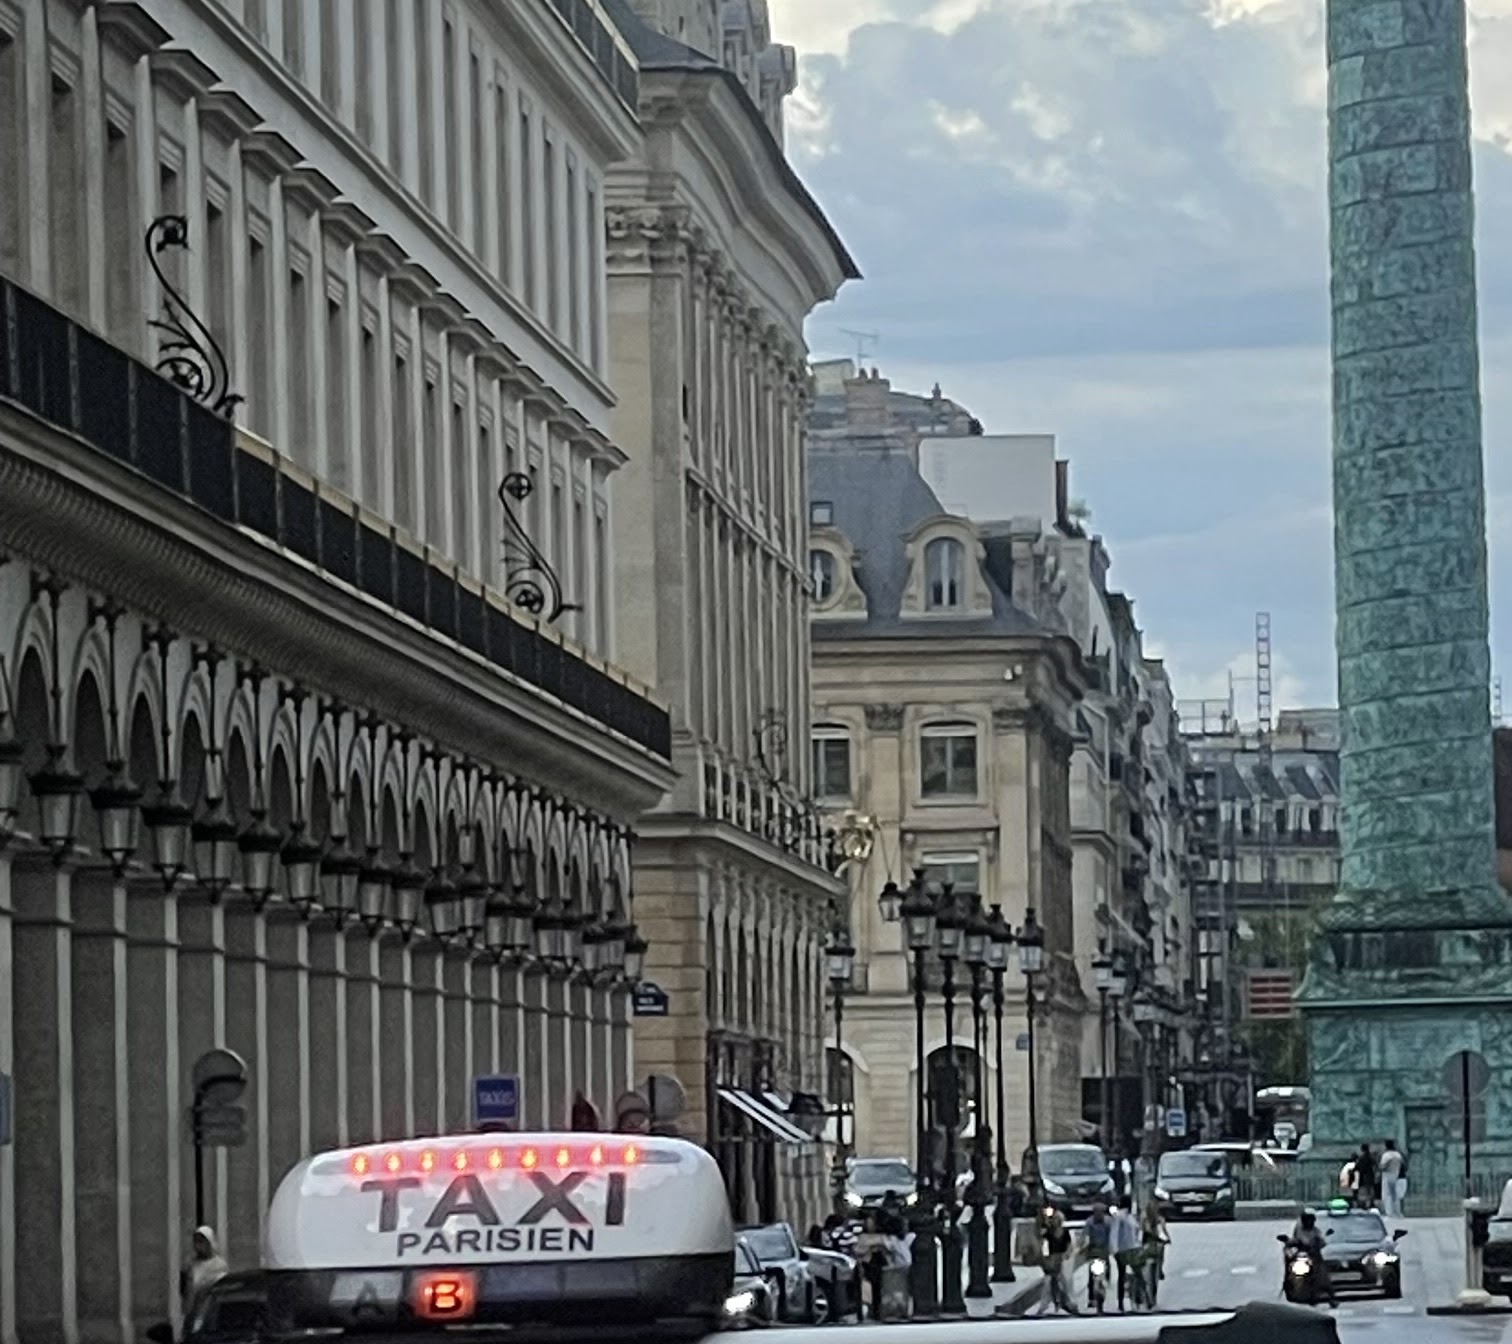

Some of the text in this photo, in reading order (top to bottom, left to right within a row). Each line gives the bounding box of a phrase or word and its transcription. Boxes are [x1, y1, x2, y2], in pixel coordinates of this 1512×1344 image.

[360, 1171, 627, 1233] TAXI
[397, 1227, 595, 1257] PARISIEN
[429, 1279, 464, 1313] B
